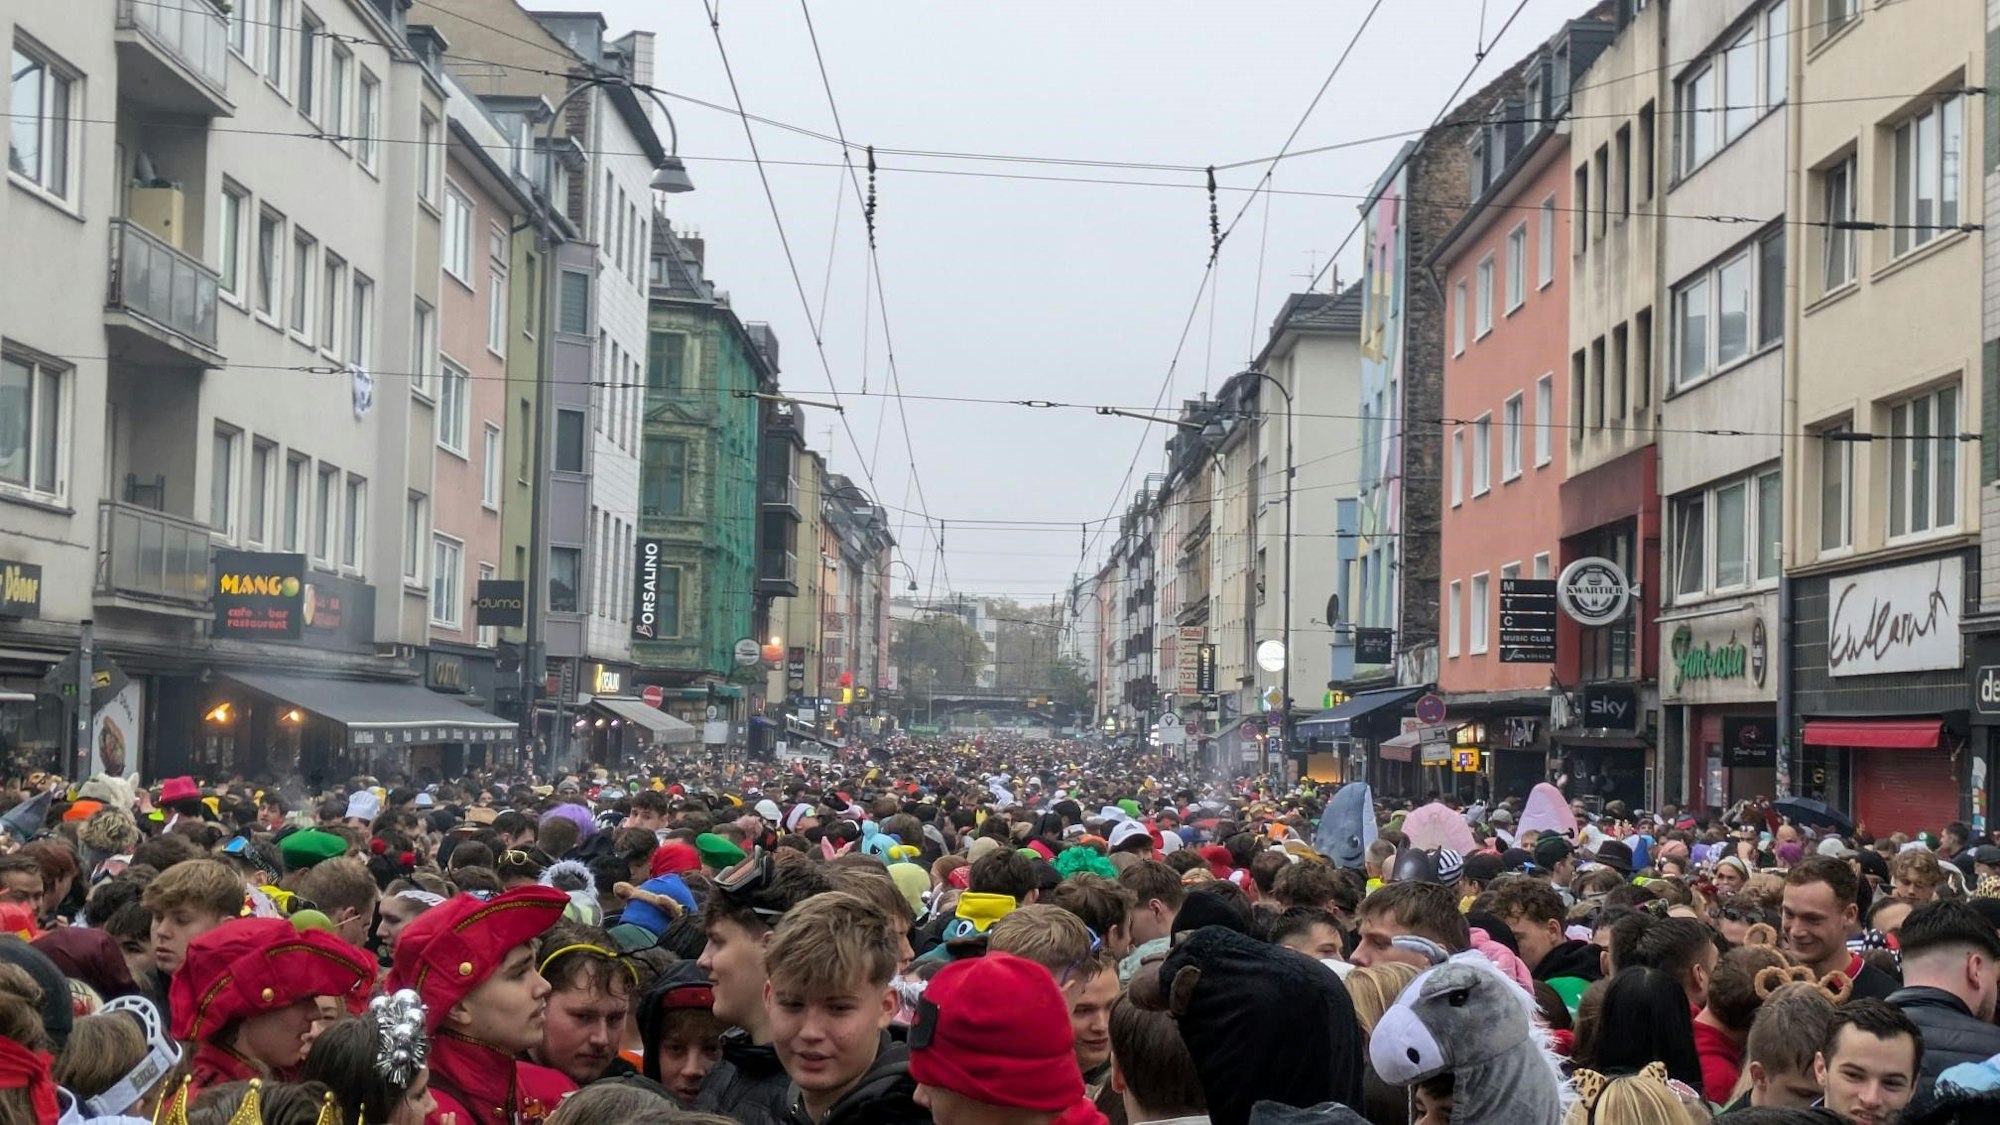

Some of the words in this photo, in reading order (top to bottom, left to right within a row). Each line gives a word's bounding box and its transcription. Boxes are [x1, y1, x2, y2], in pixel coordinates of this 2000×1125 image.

[221, 574, 299, 597] MANGO
[635, 542, 658, 638] BORSALINO
[1566, 586, 1623, 595] KWARTIER
[1590, 695, 1628, 719] sky
